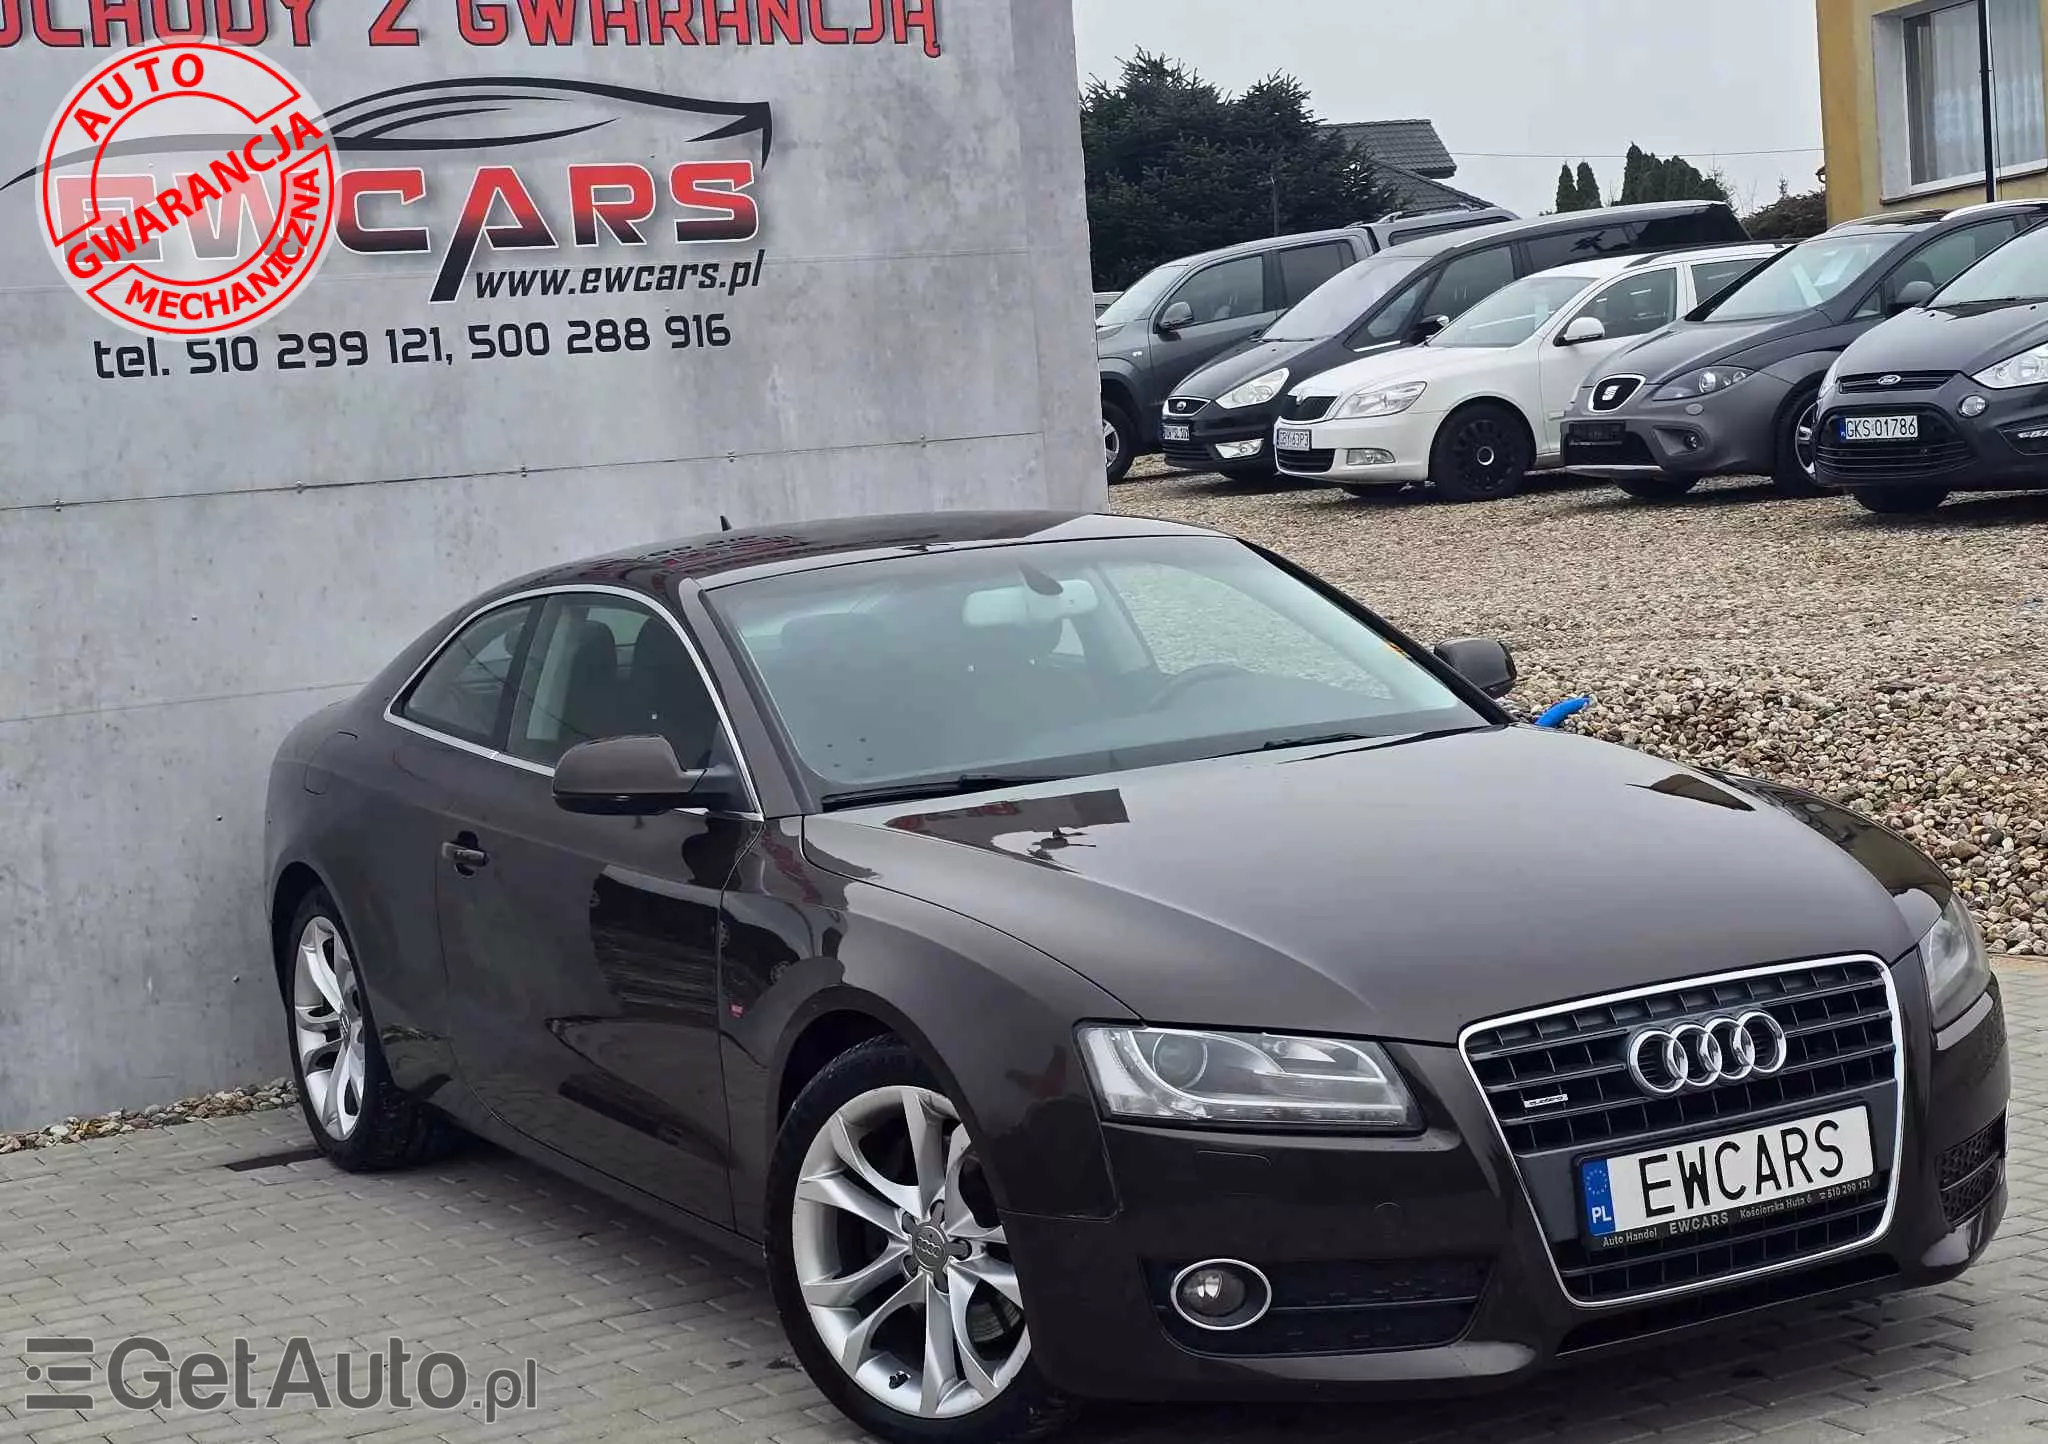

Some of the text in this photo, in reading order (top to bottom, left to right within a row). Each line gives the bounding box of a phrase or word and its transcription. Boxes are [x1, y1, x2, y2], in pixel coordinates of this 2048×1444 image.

[0, 0, 312, 47] CHODY
[475, 249, 766, 298] www.ewcars.pl
[93, 313, 732, 378] tel. 510 299 121, 500 288 916
[1638, 1119, 1844, 1218] EWCARS
[1591, 1205, 1612, 1224] PL
[1602, 1235, 1624, 1248] Auto
[1625, 1228, 1658, 1243] Handel
[1669, 1212, 1729, 1235] EWCARS
[1842, 1182, 1857, 1195] 299
[1858, 1179, 1871, 1191] 121
